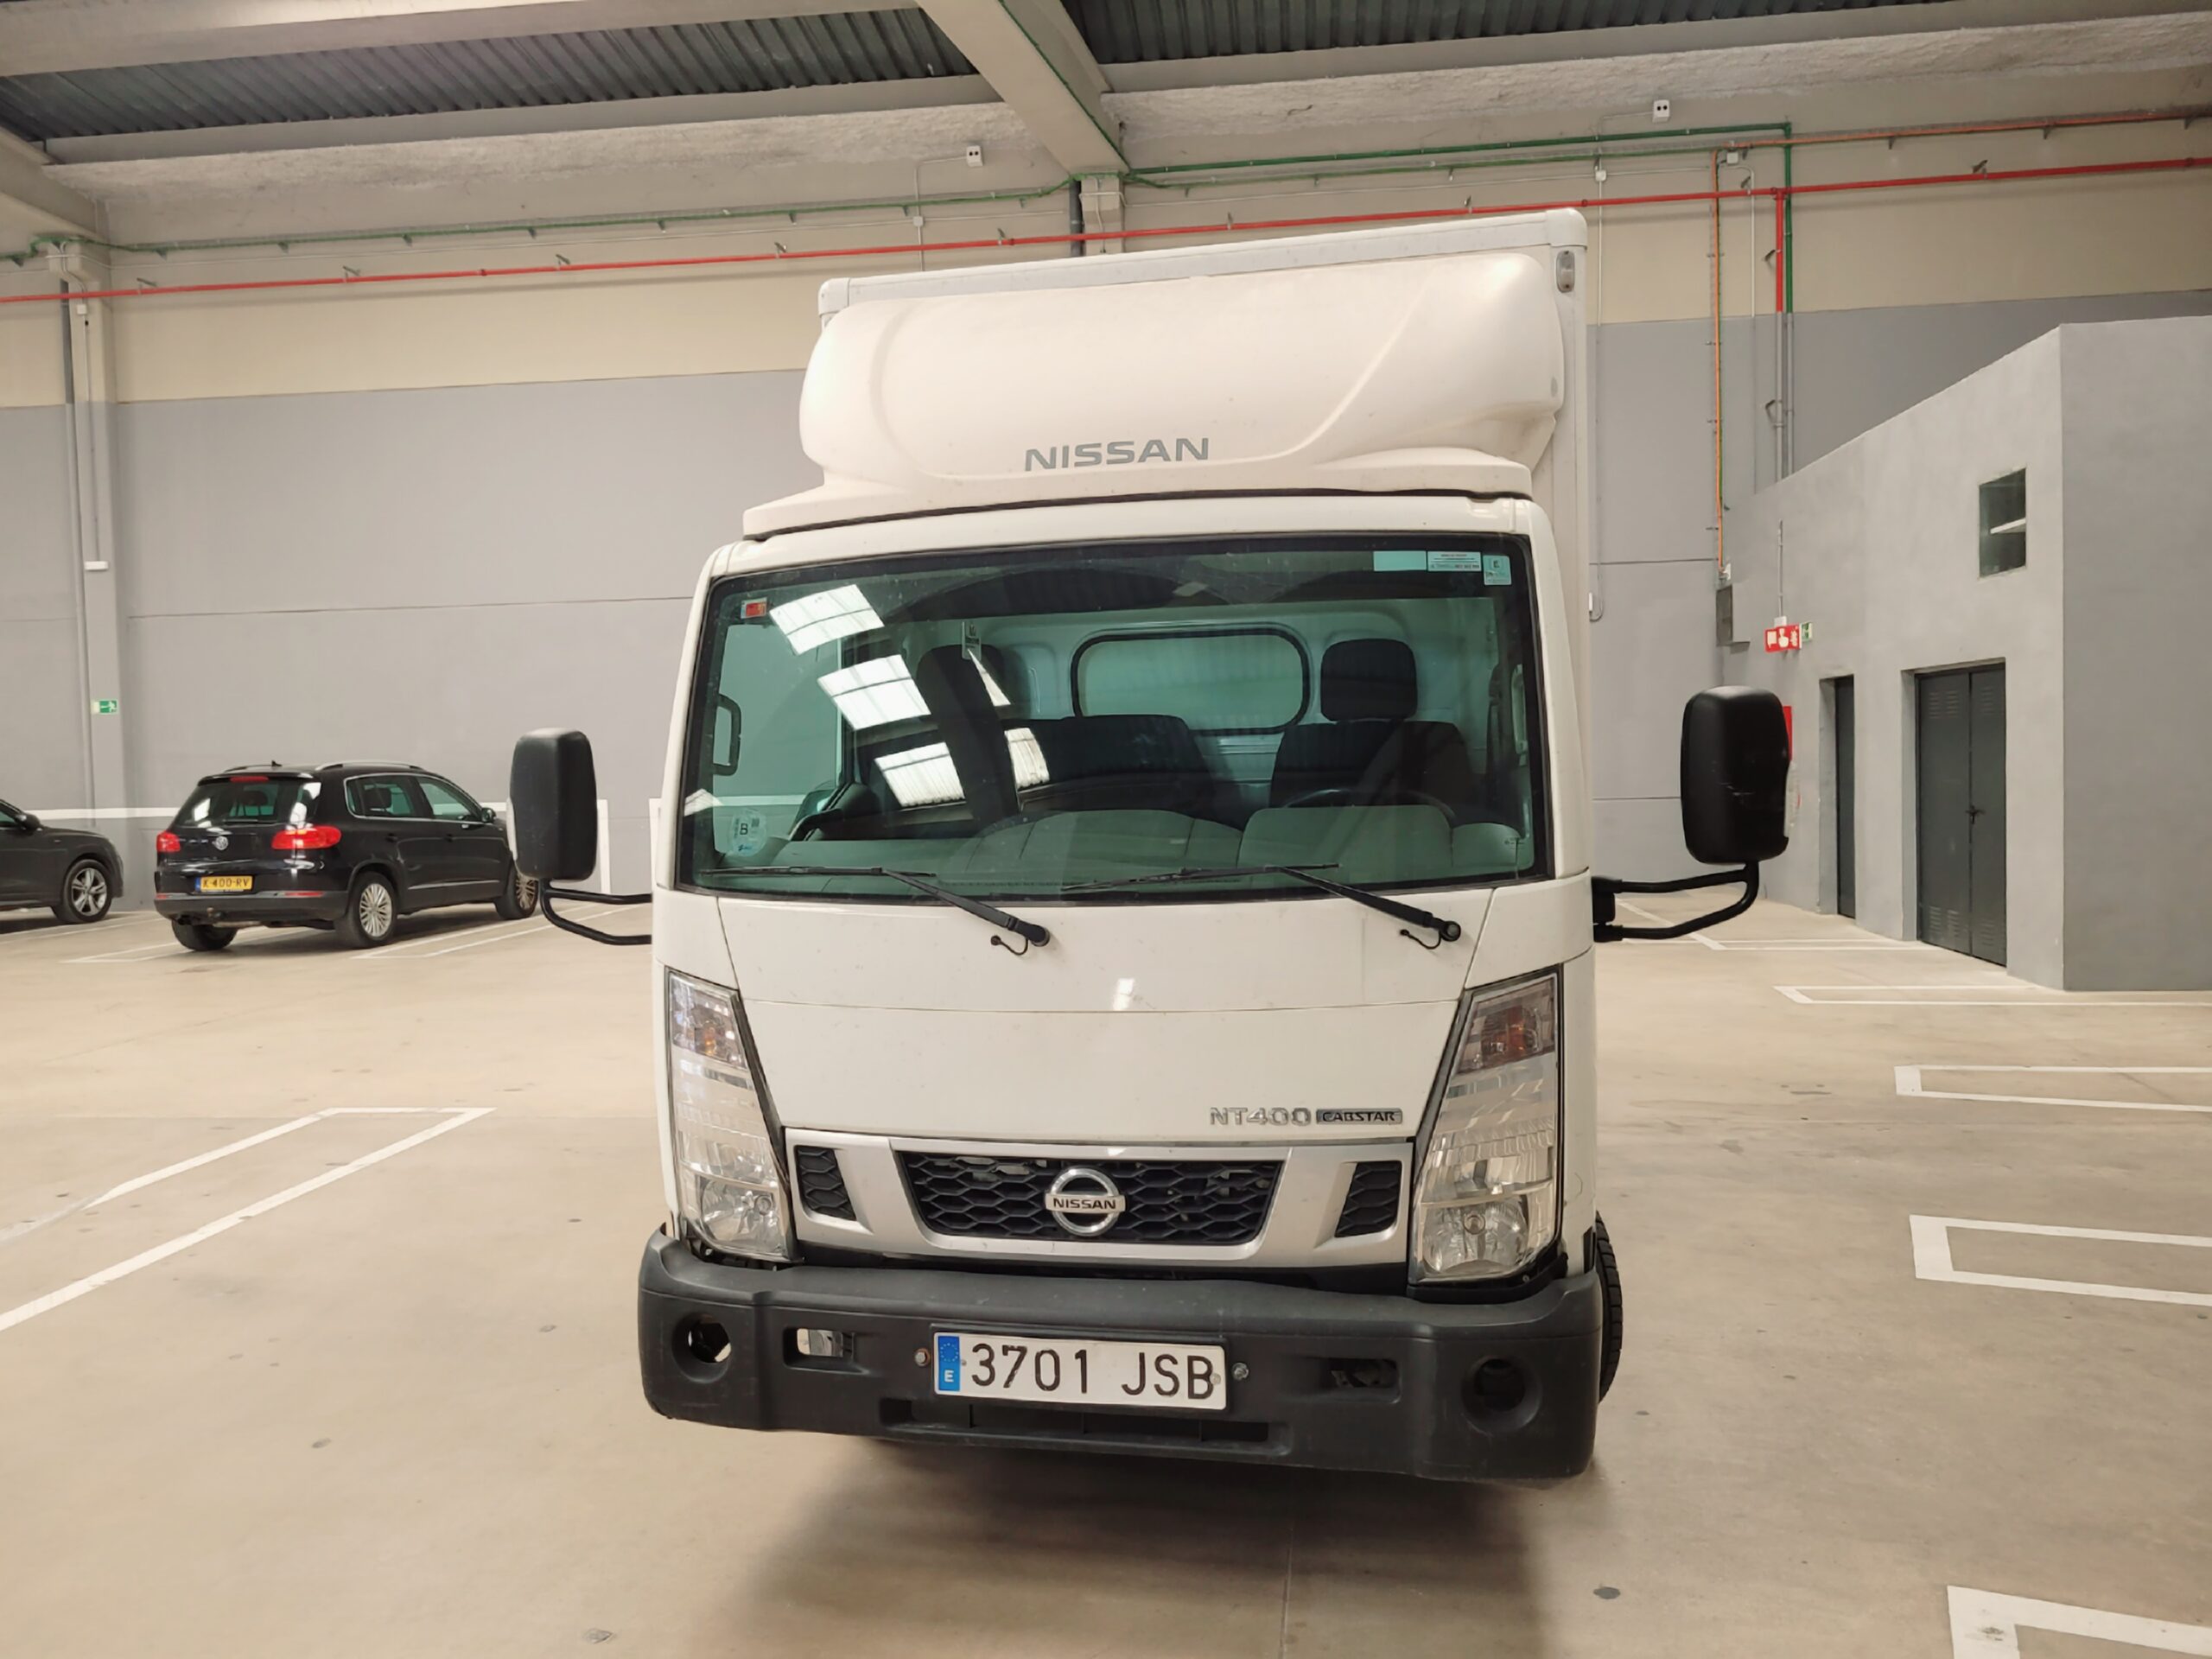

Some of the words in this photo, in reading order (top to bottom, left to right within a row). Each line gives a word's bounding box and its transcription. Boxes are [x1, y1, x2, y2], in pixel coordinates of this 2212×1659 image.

[1025, 437, 1209, 472] NISSAN
[739, 823, 748, 836] B
[1210, 1107, 1312, 1126] NT400
[1320, 1109, 1397, 1122] CABSTAR
[1053, 1198, 1116, 1210] NISSAN
[944, 1369, 954, 1382] E
[971, 1343, 1089, 1395] 3701
[1121, 1351, 1214, 1400] JSB
